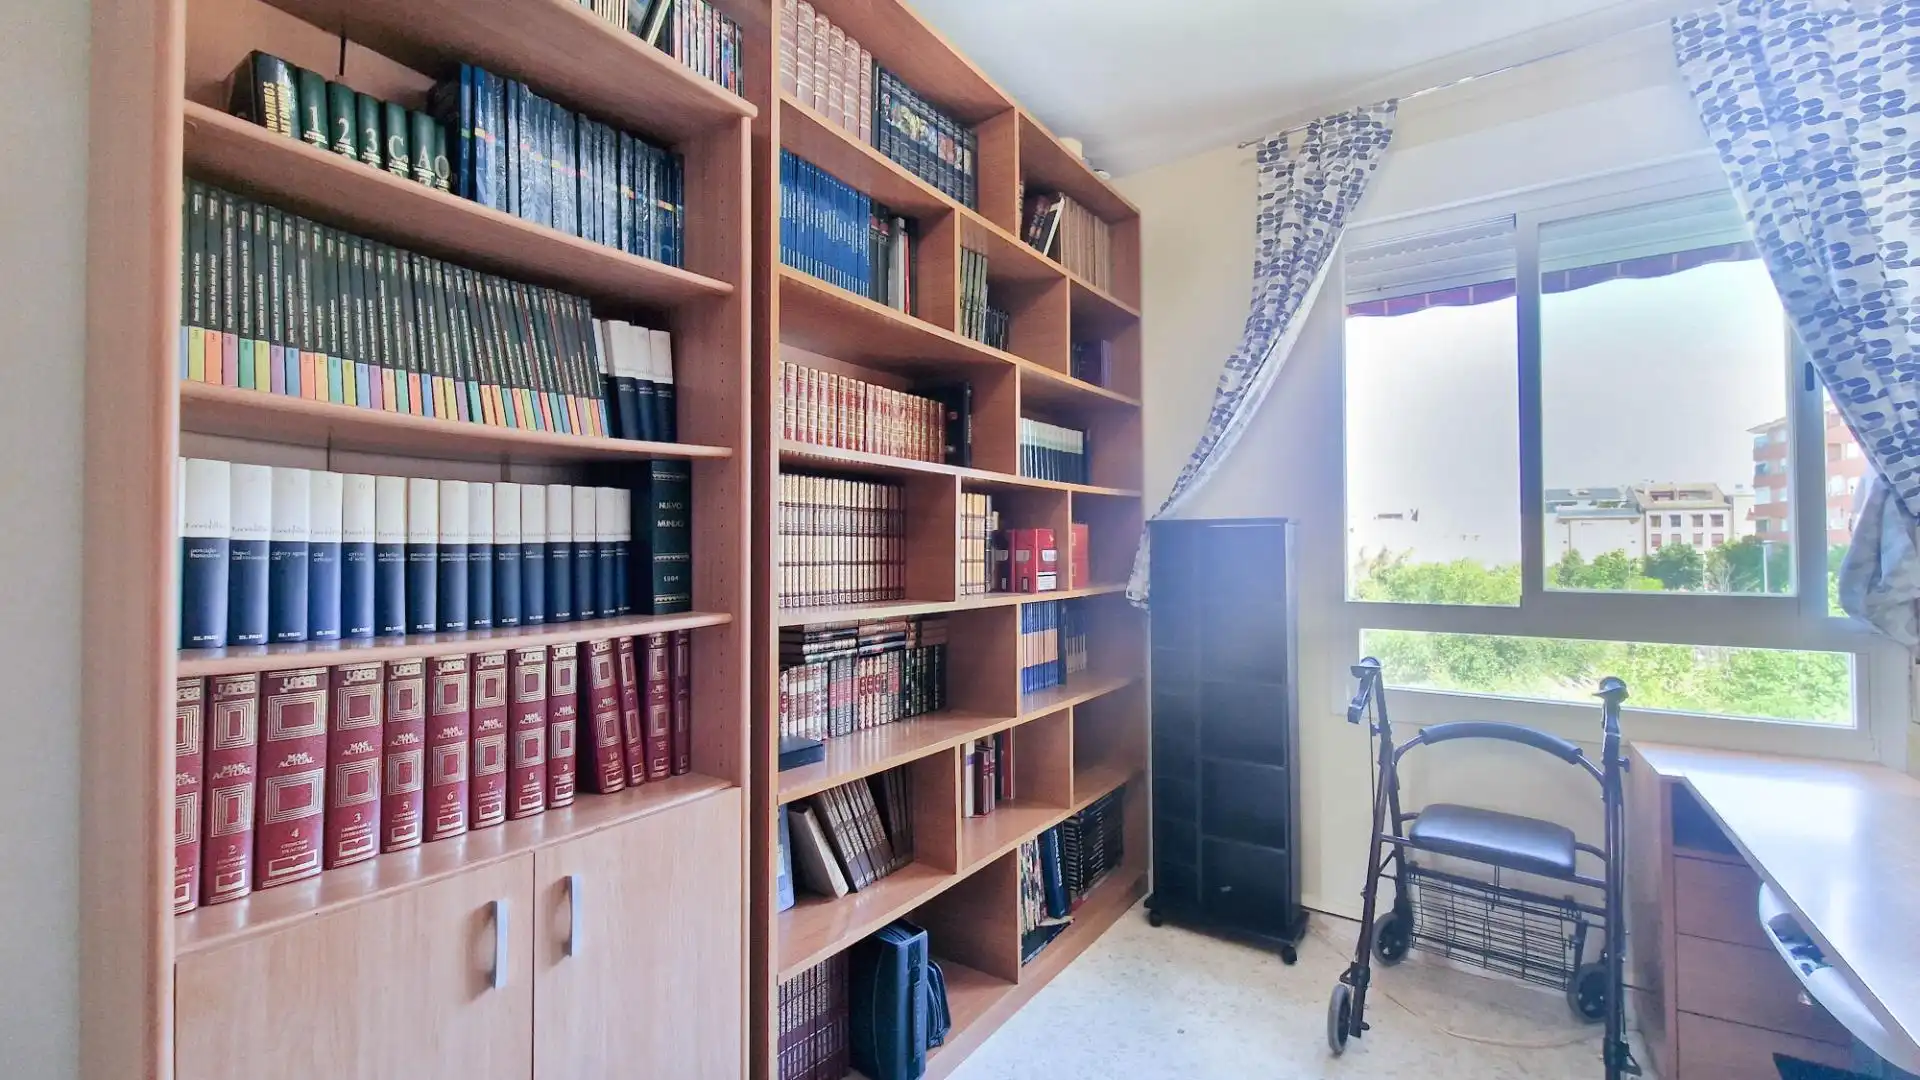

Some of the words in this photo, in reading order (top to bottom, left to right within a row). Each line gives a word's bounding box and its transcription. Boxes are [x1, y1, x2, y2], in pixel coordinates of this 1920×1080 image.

[264, 82, 278, 132] INONIMOS
[310, 106, 320, 132] 1
[338, 118, 350, 145] 2
[366, 128, 378, 153] 3
[608, 751, 618, 760] 10
[446, 790, 456, 800] 6
[352, 812, 362, 823] 3
[291, 828, 300, 838] 4
